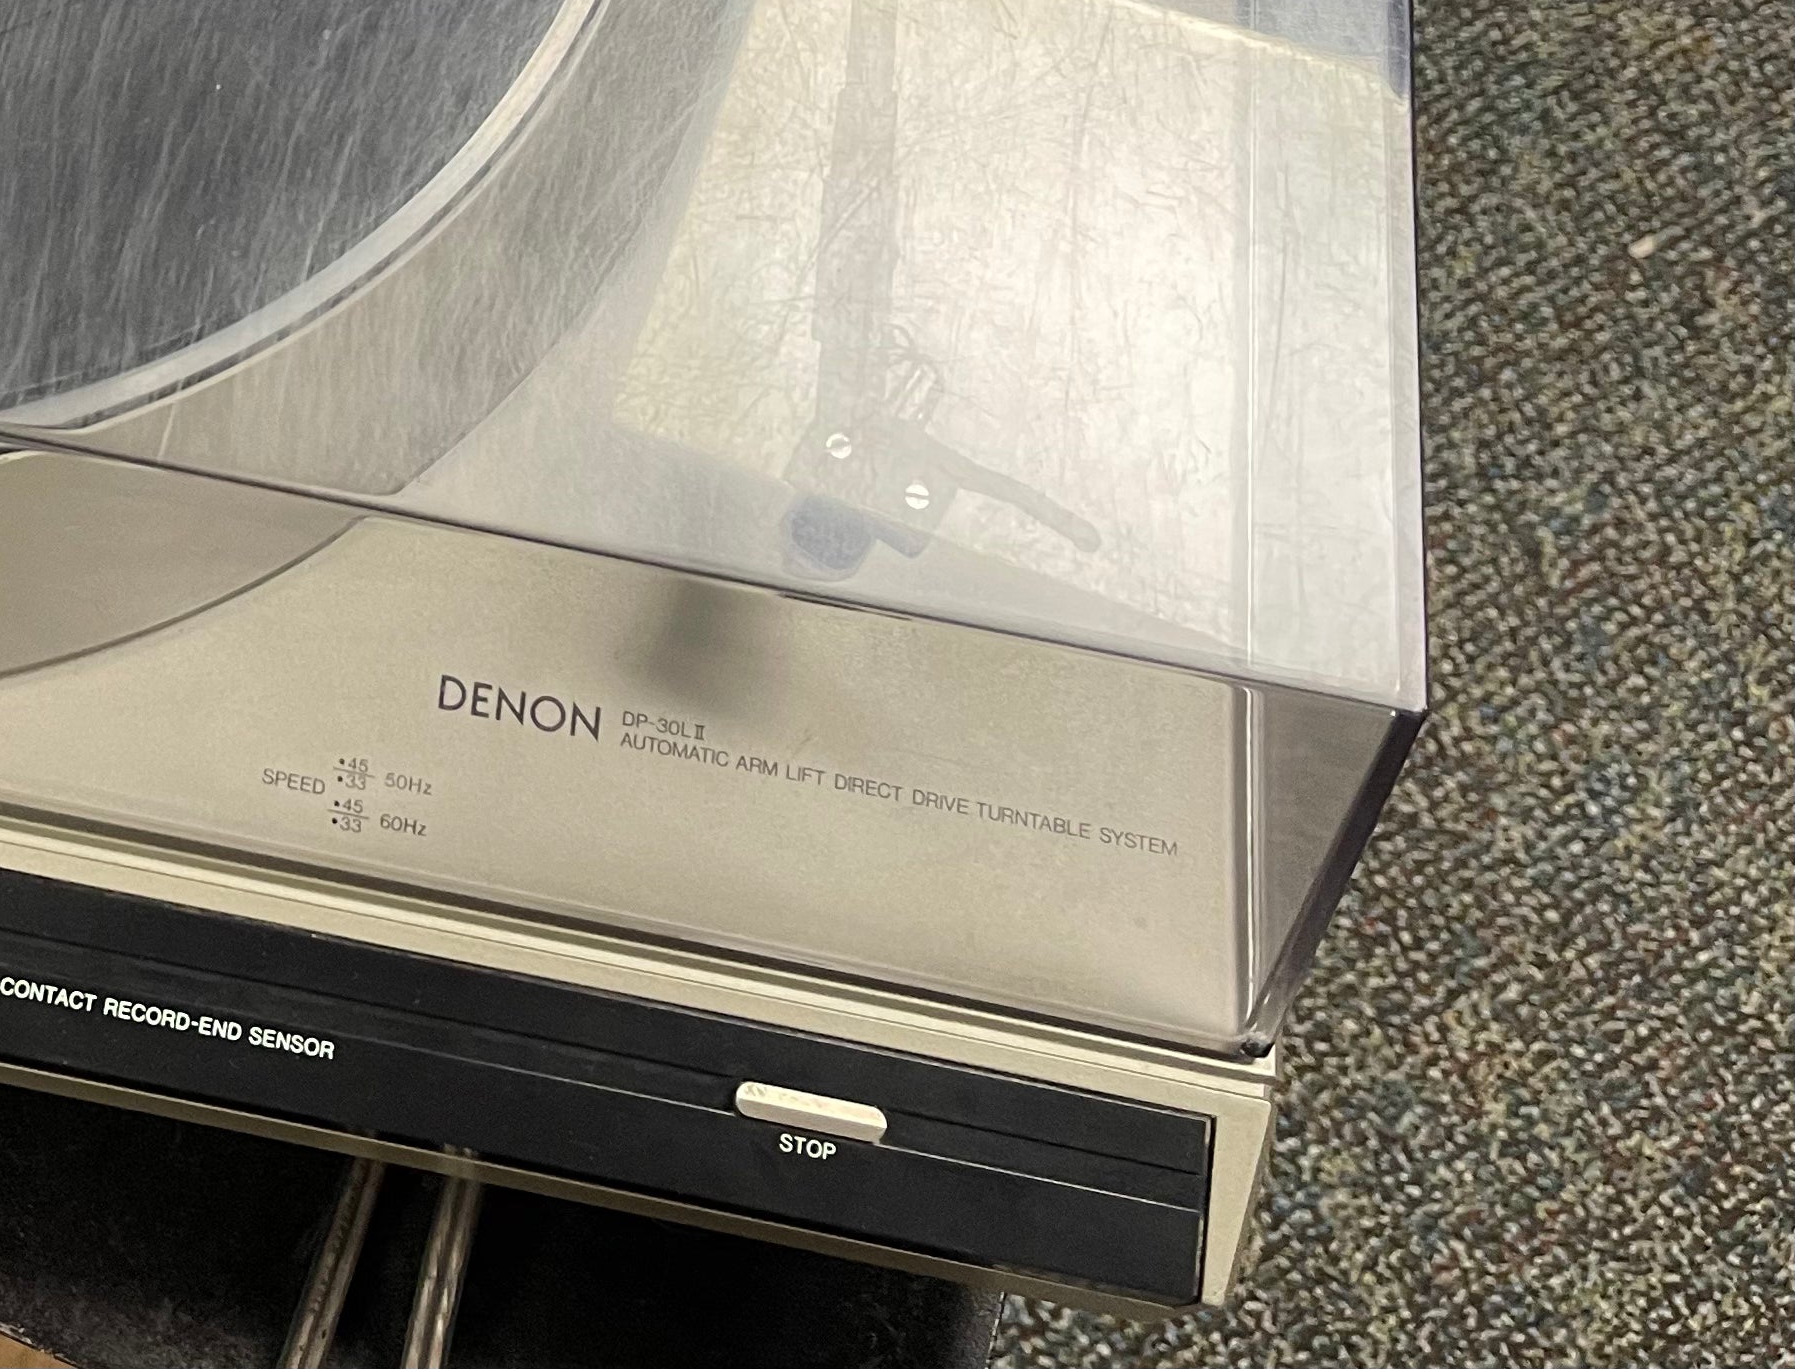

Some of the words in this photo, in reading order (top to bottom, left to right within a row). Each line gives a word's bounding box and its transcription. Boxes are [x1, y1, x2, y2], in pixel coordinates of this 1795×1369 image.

[438, 674, 601, 742] DENON
[261, 768, 326, 795] SPEED
[384, 772, 433, 796] 50Hz
[620, 732, 730, 768] AUTOMATIC
[735, 755, 779, 777] ARM
[785, 764, 826, 786] LIFT
[834, 773, 903, 802] DIRECT
[912, 789, 970, 815] DRIVE
[977, 801, 1091, 840] TURNTABLE
[1099, 827, 1178, 857] SYSTEM
[379, 813, 427, 837] 60Hz
[103, 997, 242, 1041] RECORD-END
[247, 1026, 335, 1060] SENSOR
[779, 1133, 837, 1160] STOP
